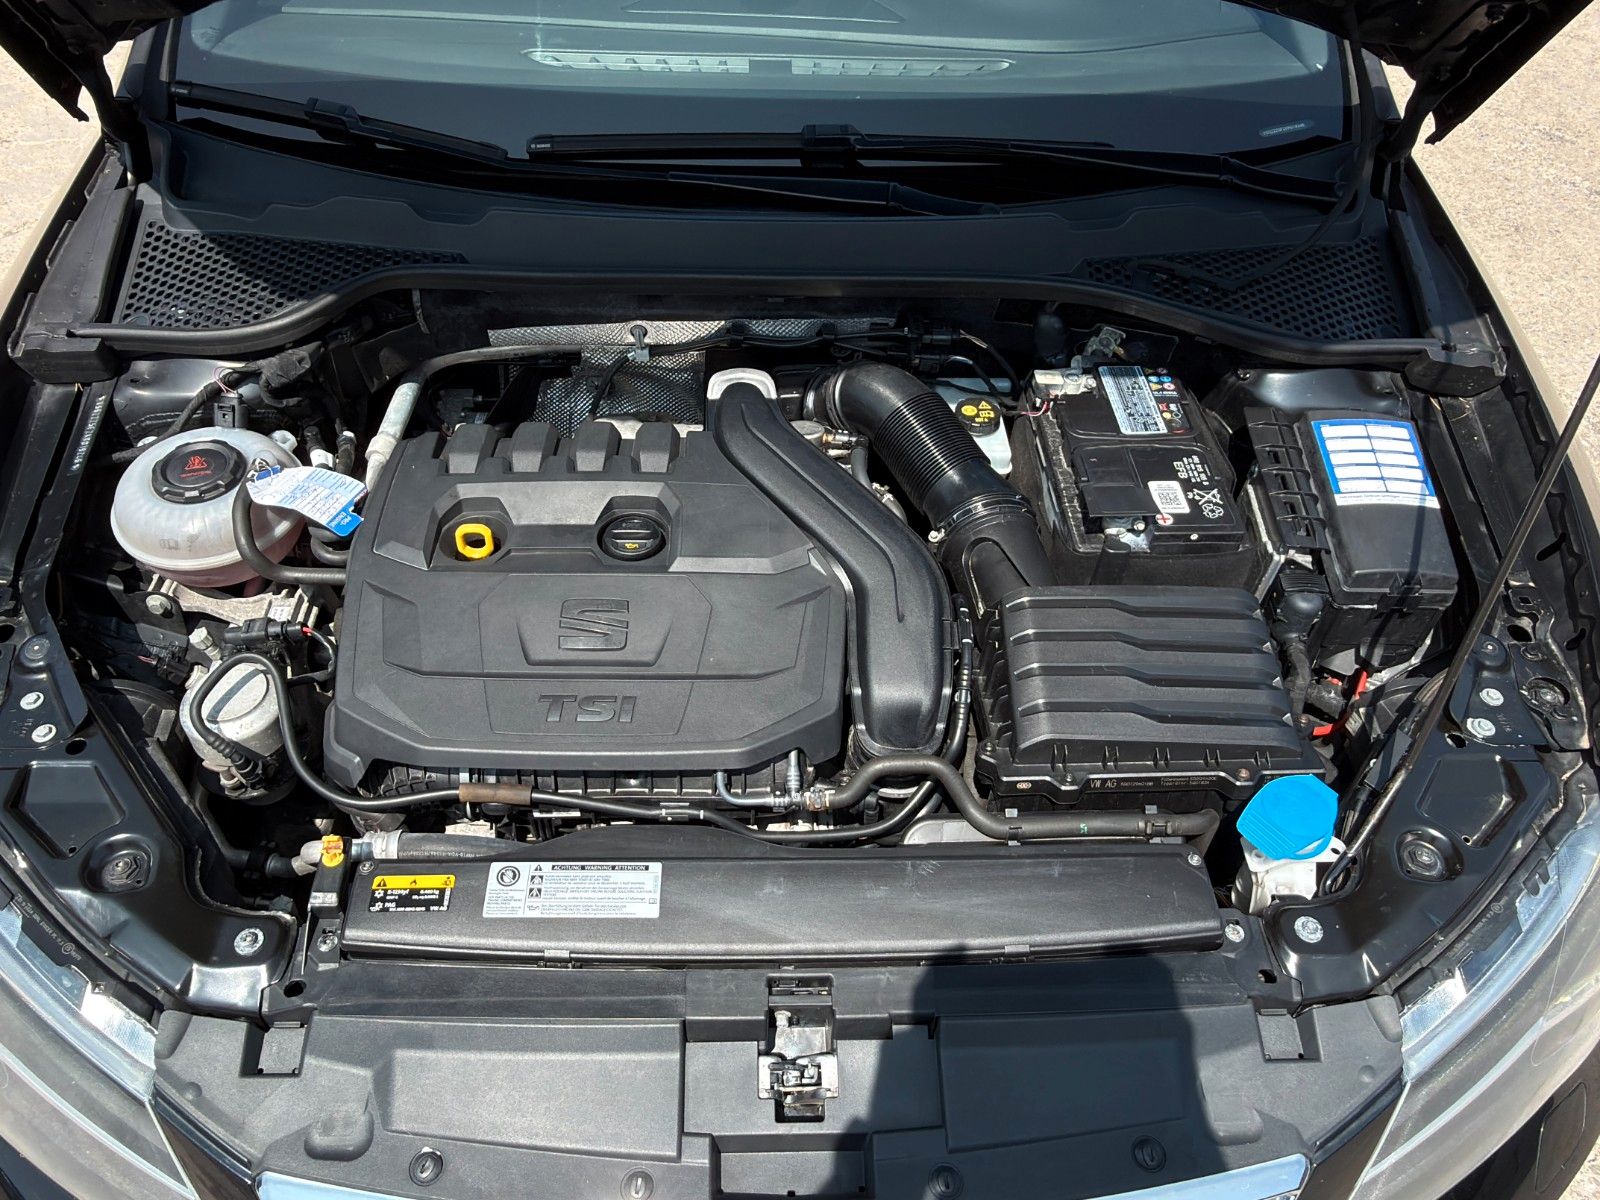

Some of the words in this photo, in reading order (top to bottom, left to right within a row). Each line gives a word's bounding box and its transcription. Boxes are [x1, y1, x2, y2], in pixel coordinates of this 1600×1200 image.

[1173, 461, 1188, 478] EFB
[539, 694, 636, 722] TSI
[1090, 779, 1101, 788] VW
[1105, 779, 1117, 788] AG
